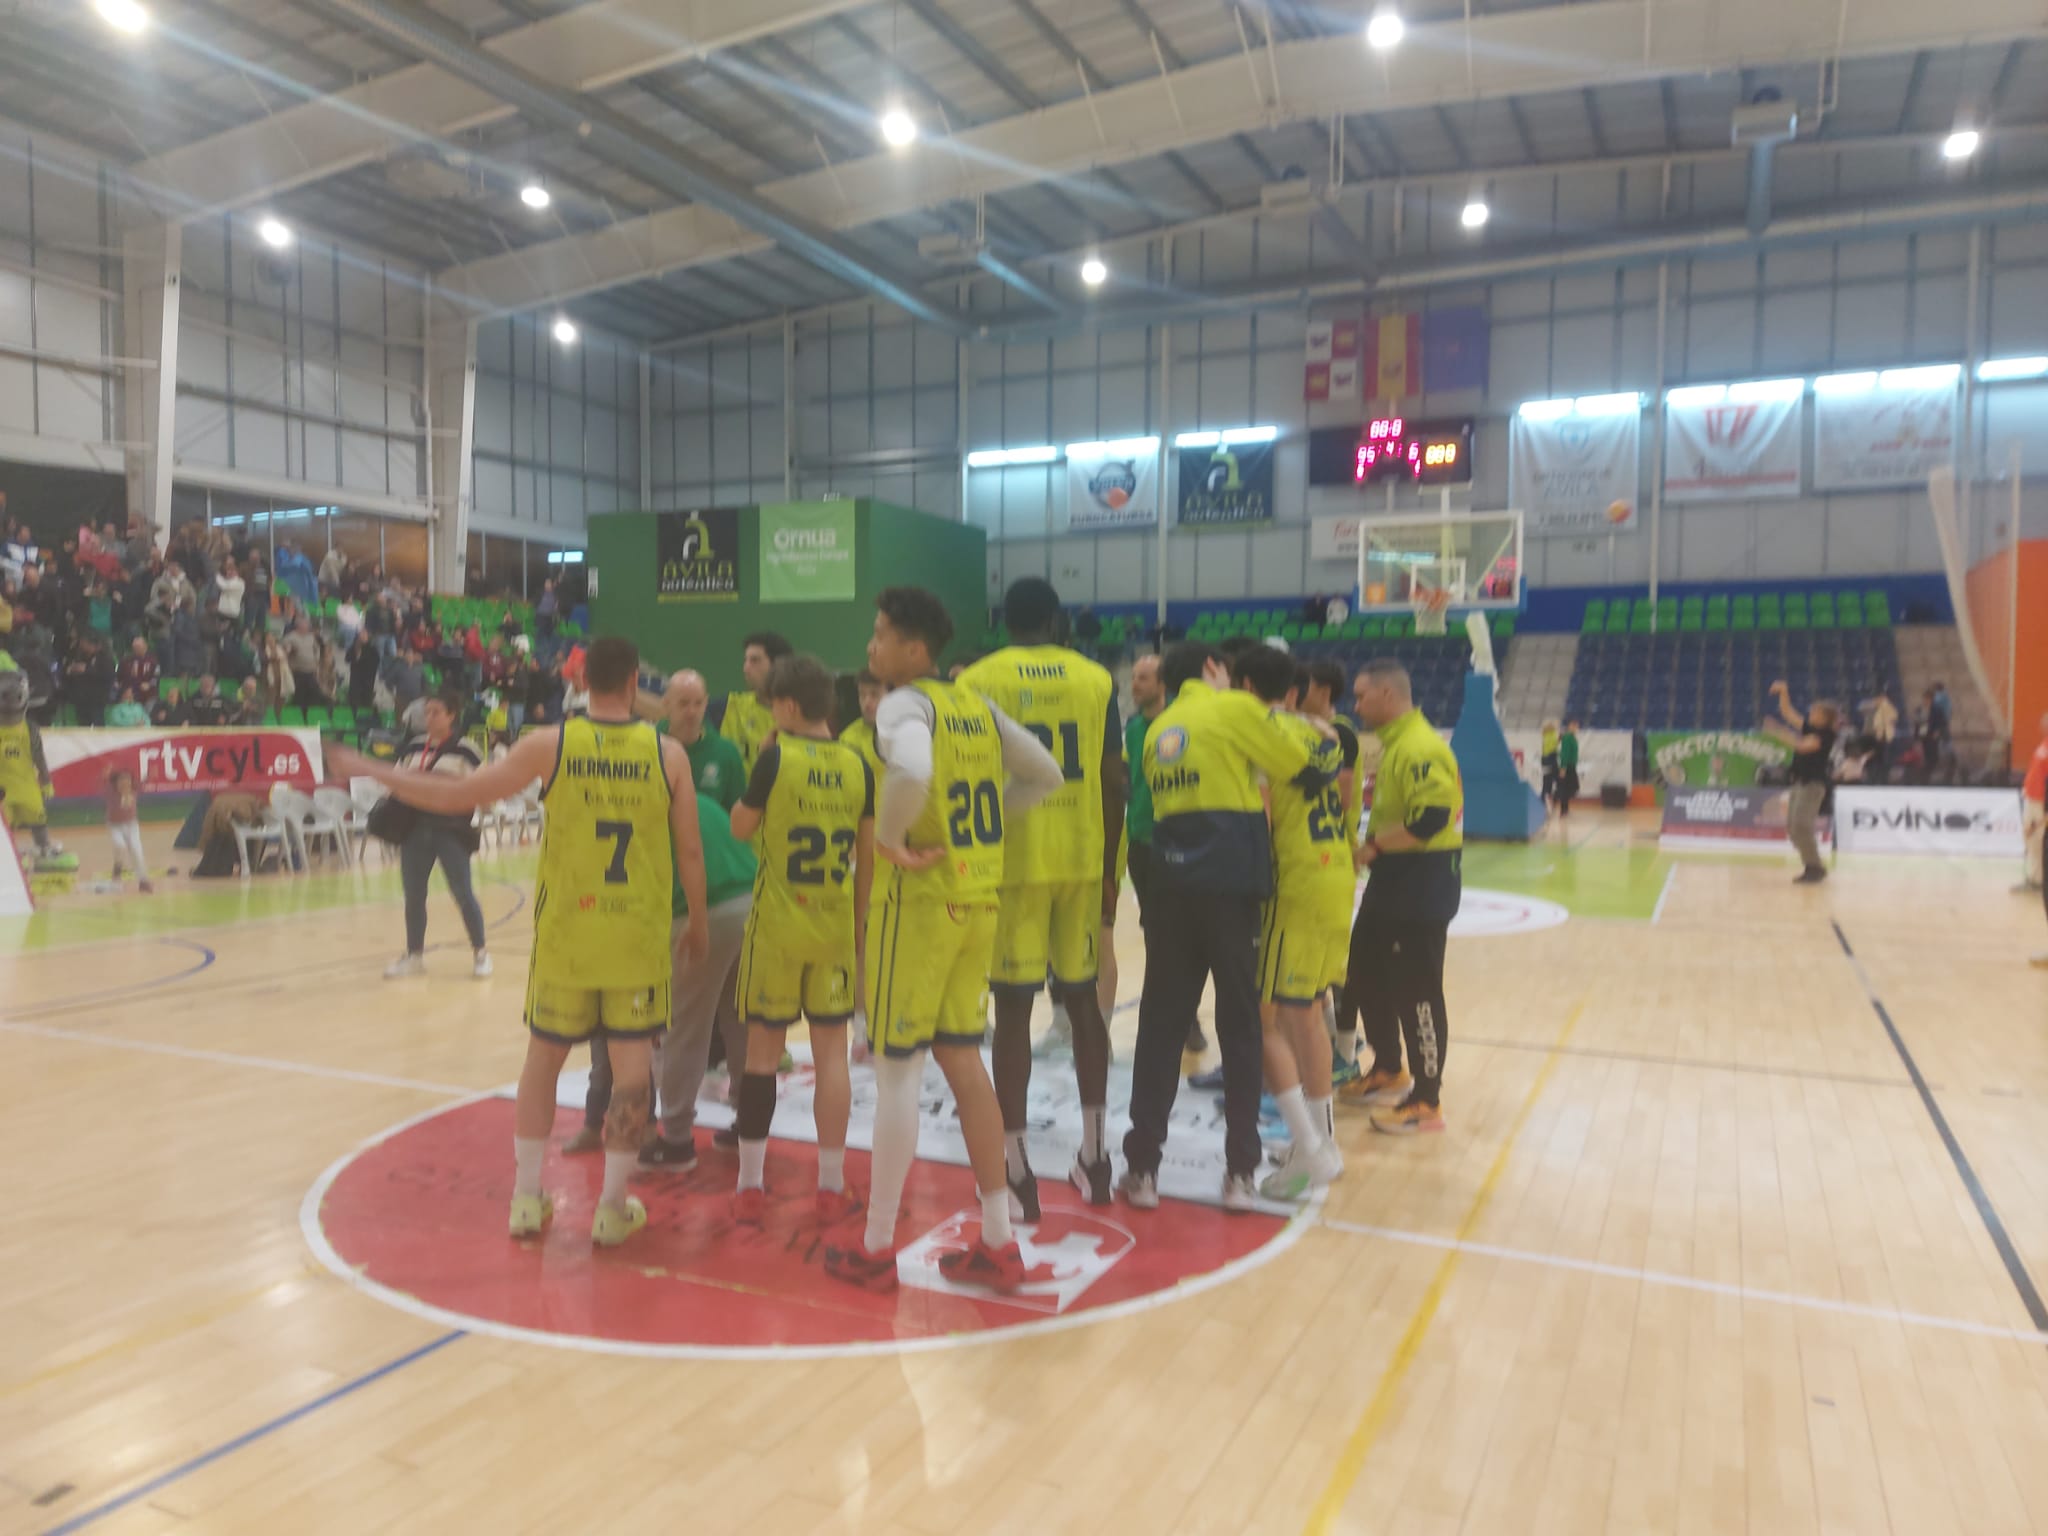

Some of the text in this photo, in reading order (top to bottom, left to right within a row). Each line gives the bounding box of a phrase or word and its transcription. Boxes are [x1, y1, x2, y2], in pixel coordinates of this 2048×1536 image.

[139, 738, 300, 783] rtvcyl.es
[948, 779, 1003, 847] 20
[595, 820, 634, 884] 7
[787, 825, 857, 886] 23
[1416, 1000, 1438, 1078] adidas
